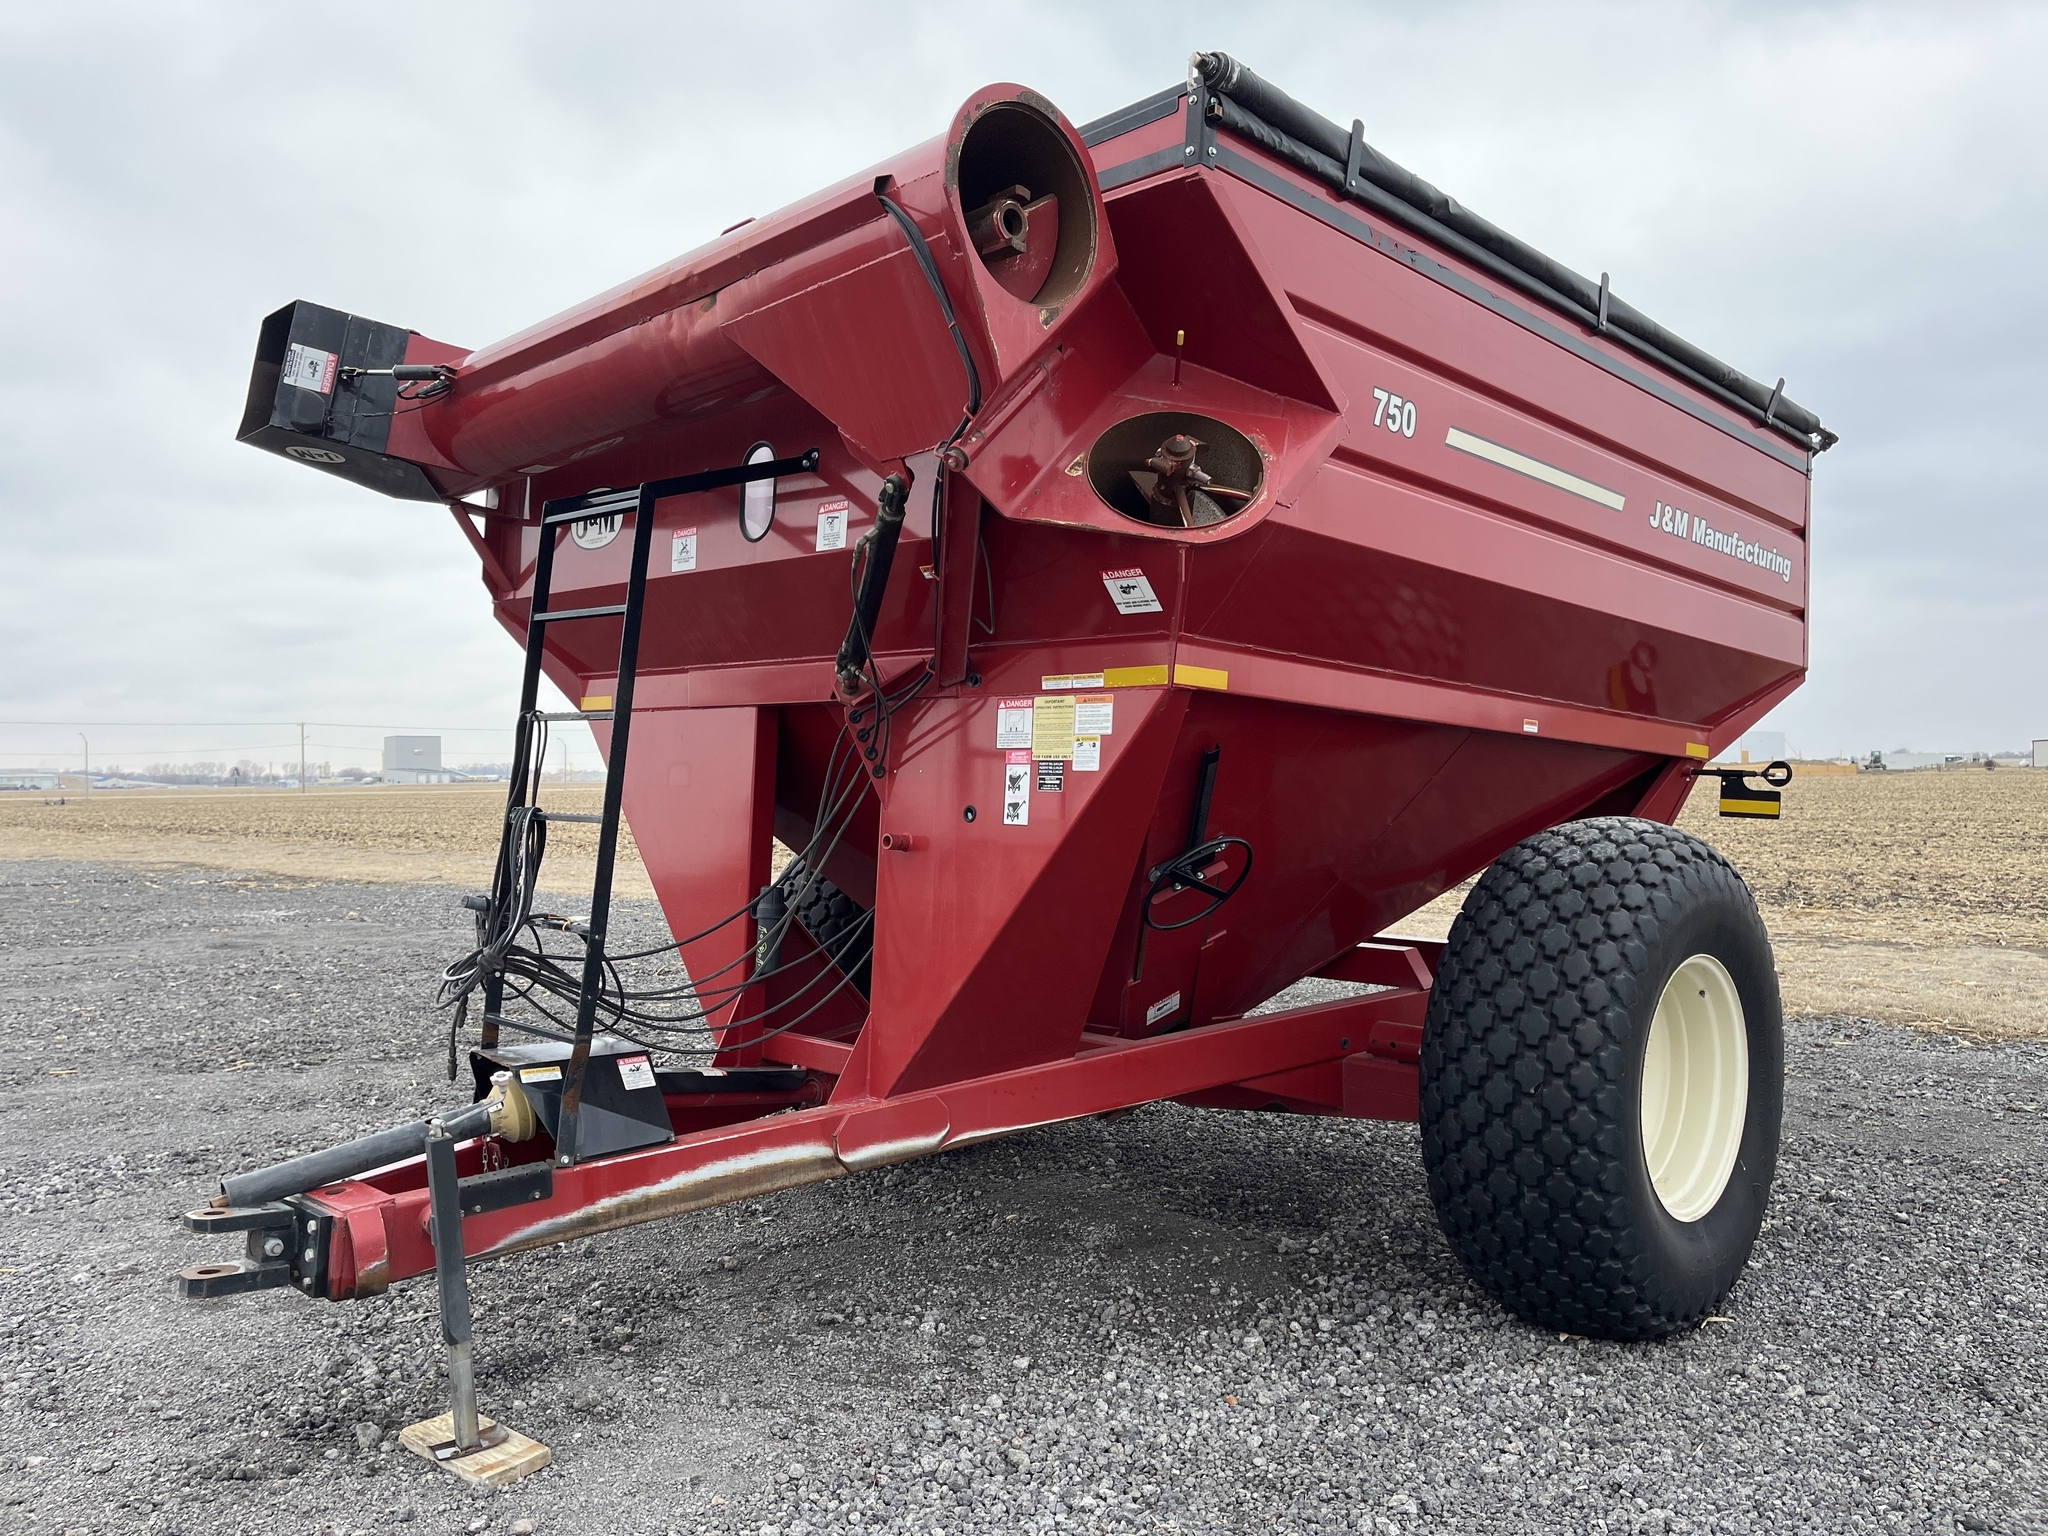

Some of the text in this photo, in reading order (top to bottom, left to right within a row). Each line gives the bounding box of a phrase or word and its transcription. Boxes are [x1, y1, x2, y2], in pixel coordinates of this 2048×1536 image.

[321, 362, 335, 392] DANGER
[1372, 385, 1417, 439] 750
[824, 500, 848, 511] DANGER
[677, 528, 697, 538] DANGER
[1649, 500, 1792, 583] J&M Manufacturing
[1107, 568, 1144, 579] DANGER
[1006, 699, 1033, 708] DANGER
[624, 1056, 647, 1064] DANGER
